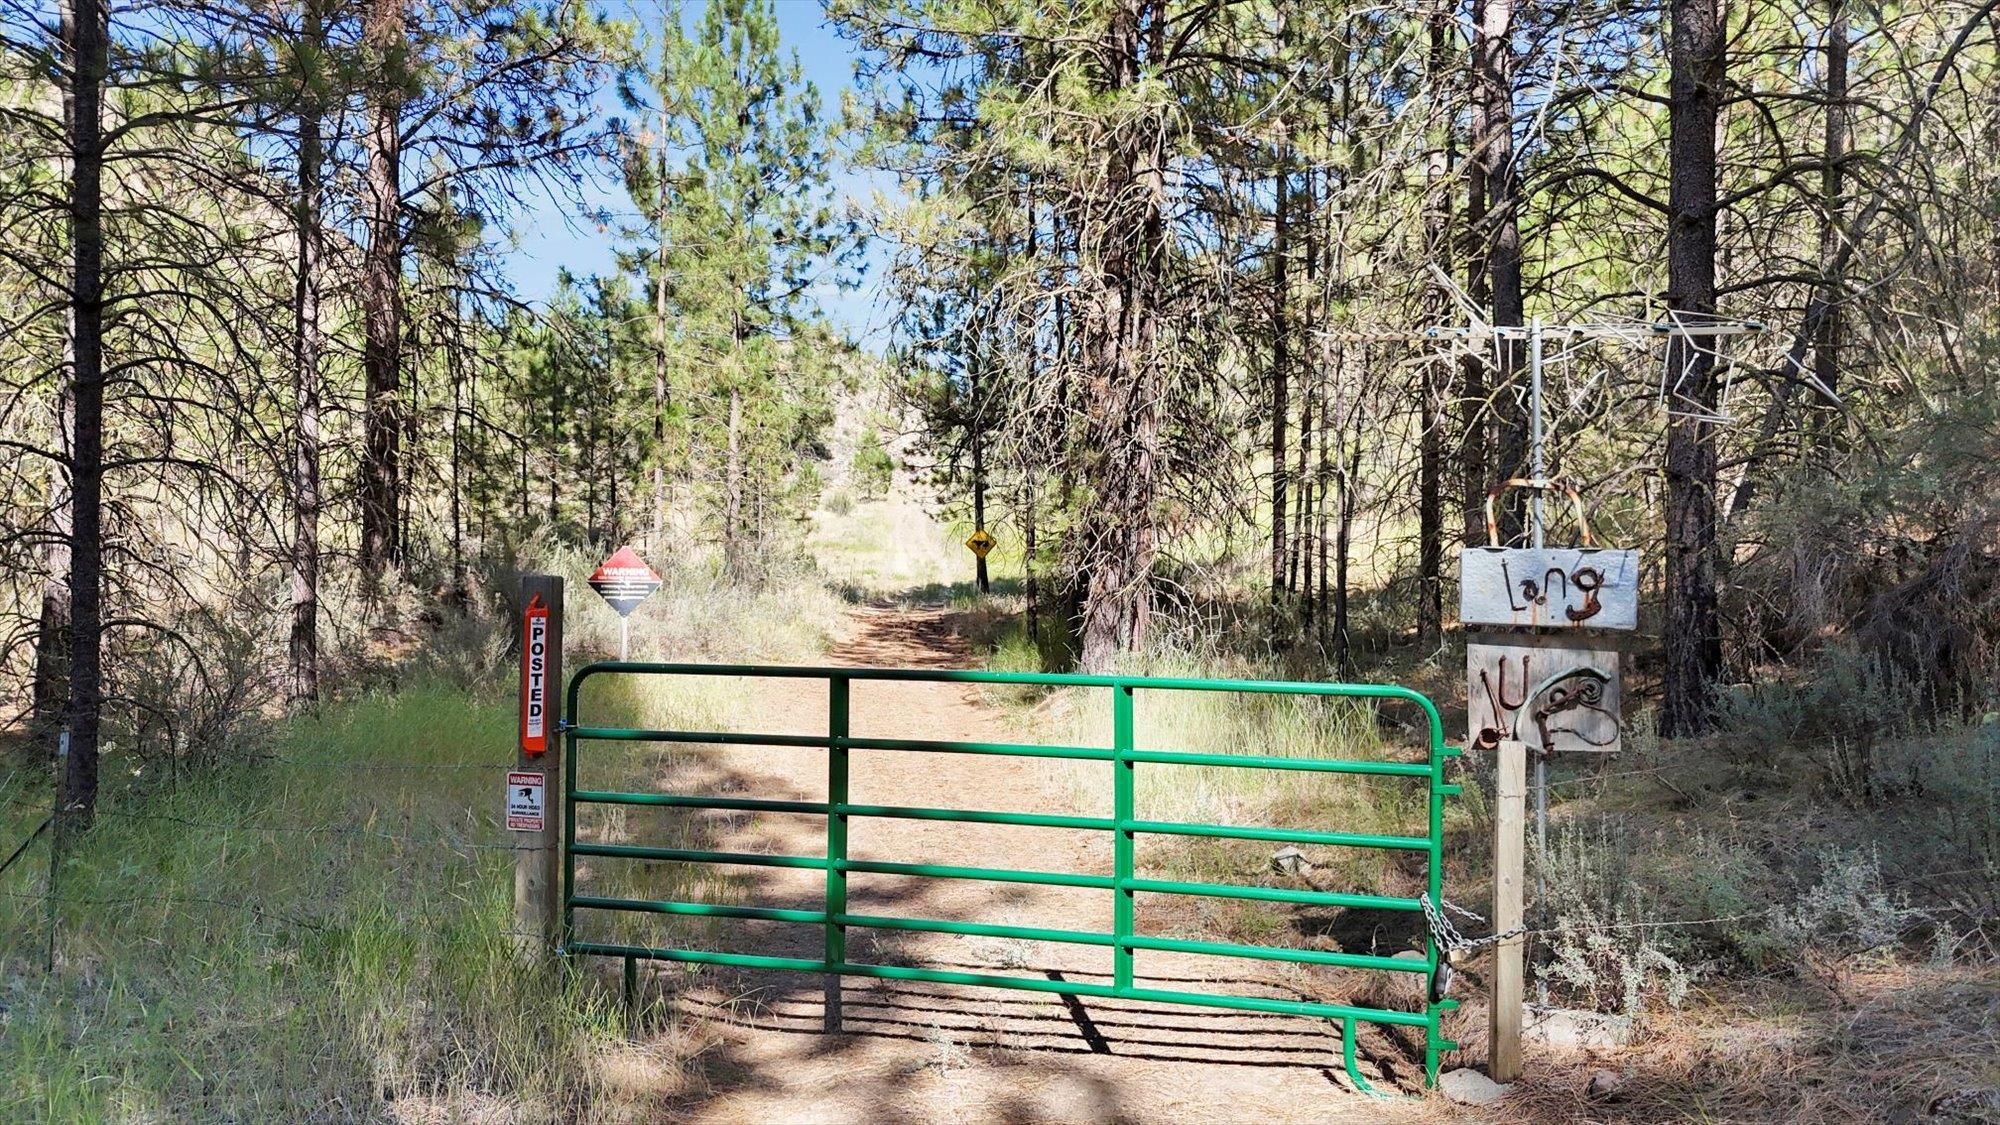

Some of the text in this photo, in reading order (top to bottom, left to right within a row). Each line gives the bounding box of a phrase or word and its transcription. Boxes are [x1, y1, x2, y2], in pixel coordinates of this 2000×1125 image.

[602, 567, 650, 576] WARNING
[530, 627, 544, 717] POSTED
[510, 776, 542, 785] WARNING
